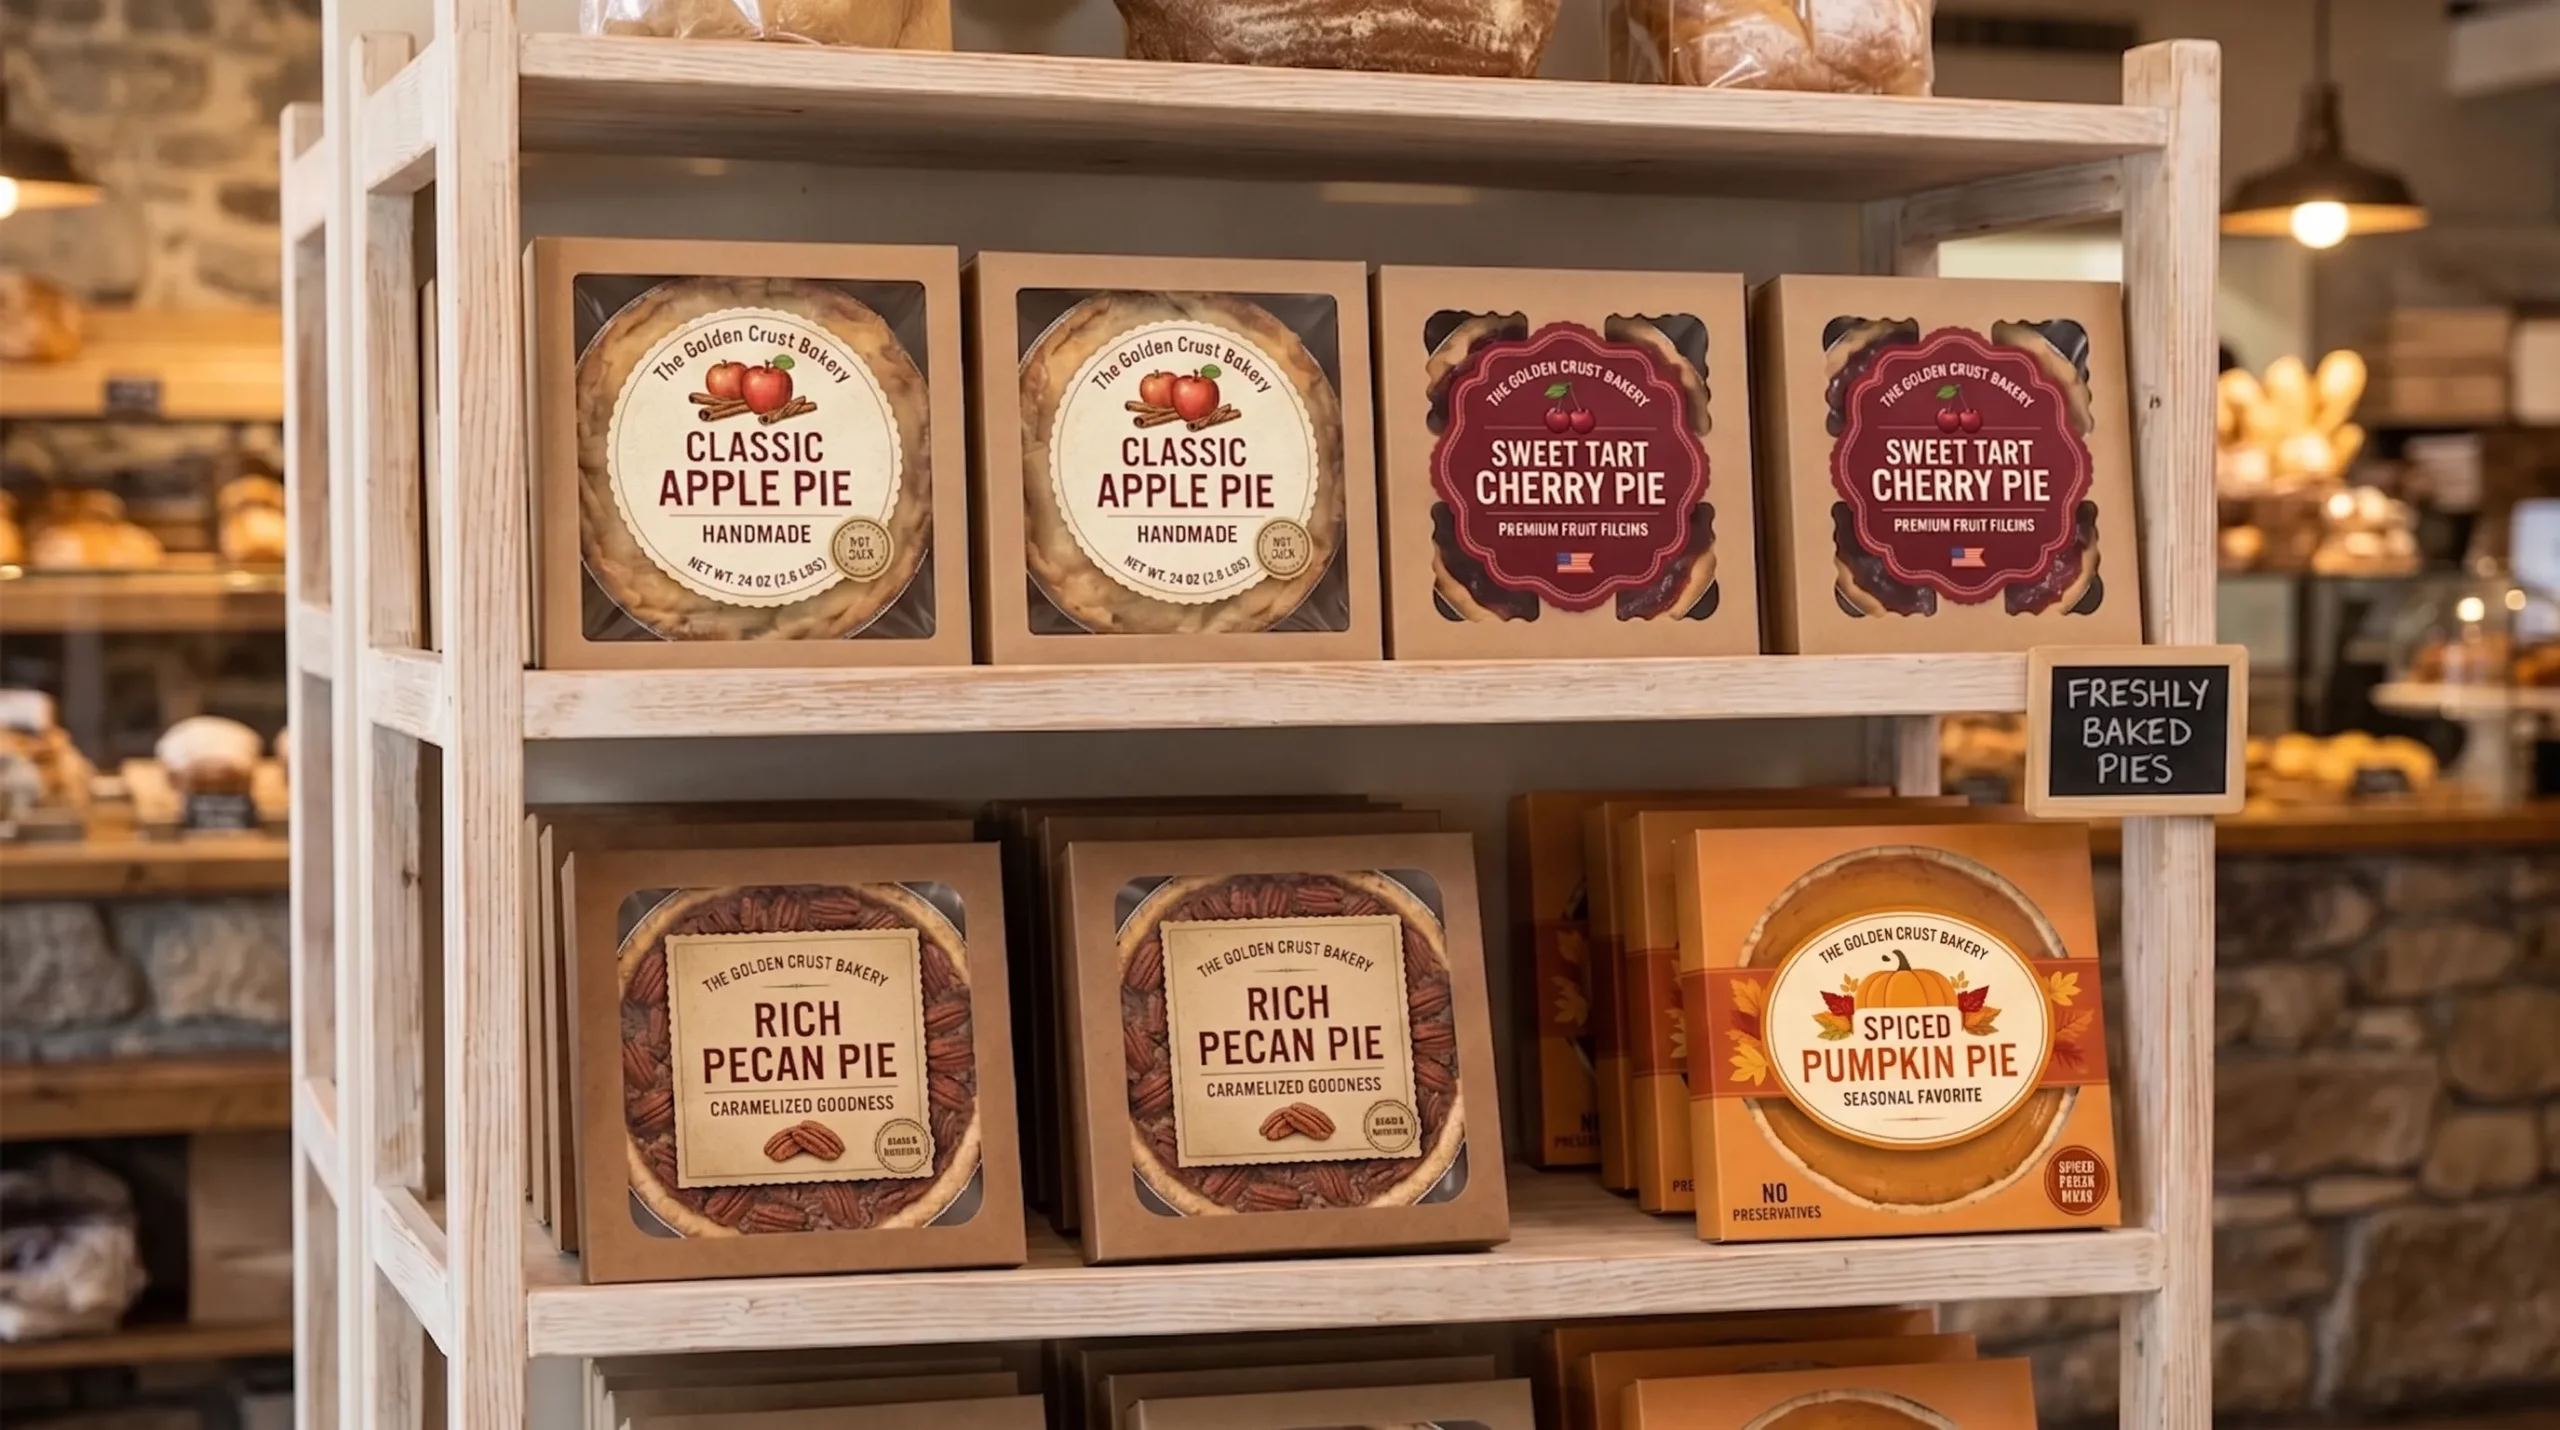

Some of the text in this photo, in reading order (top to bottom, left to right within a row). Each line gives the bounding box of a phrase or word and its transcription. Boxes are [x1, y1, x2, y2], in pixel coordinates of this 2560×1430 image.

[653, 325, 850, 385] The Golden Crust Bakery
[1091, 336, 1272, 394] The Golden Crust Bakery
[1486, 360, 1650, 408] THE GOLDEN CRUST BAKERY
[1880, 362, 2035, 408] THE GOLDEN CRUST BAKERY
[686, 431, 823, 463] CLASSIC
[1122, 437, 1246, 466] CLASSIC
[1491, 440, 1648, 468] SWEET TART
[1886, 440, 2033, 465] SWEET TART
[659, 470, 852, 507] APPLE PIE
[1097, 474, 1274, 508] APPLE PIE
[1476, 471, 1666, 505] CHERRY PIE
[1872, 470, 2050, 501] CHERRY PIE
[702, 524, 811, 544] HANDMADE
[1137, 525, 1238, 544] HANDMADE
[1498, 522, 1558, 536] PREMIUM
[1562, 522, 1598, 536] FRUIT
[1894, 518, 1950, 532] PREMIUM
[1954, 518, 1988, 532] FRUIT
[688, 556, 712, 575] NET
[714, 568, 734, 584] WT.
[738, 574, 752, 586] 24
[800, 557, 826, 579] LBS)
[1124, 556, 1146, 573] NET
[1148, 567, 1166, 582] WT.
[1170, 572, 1182, 584] 24
[2068, 678, 2209, 710] FRESHLY
[2082, 716, 2192, 748] BAKED
[2098, 752, 2173, 784] PIES
[1196, 940, 1374, 978] THE GOLDEN CRUST BAKERY
[1819, 926, 1989, 964] THE GOLDEN CRUST BAKERY
[702, 954, 889, 993] THE GOLDEN CRUST BAKERY
[1248, 985, 1330, 1021] RICH
[754, 1001, 841, 1038] RICH
[1864, 1014, 1951, 1040] SPICED
[1199, 1026, 1384, 1066] PECAN PIE
[703, 1042, 898, 1084] PECAN PIE
[1802, 1044, 2018, 1084] PUMPKIN PIE
[1206, 1077, 1382, 1098] CARAMELIZED GOODNESS
[1843, 1087, 1982, 1107] SEASONAL FAVORITE
[710, 1095, 894, 1117] CARAMELIZED GOODNESS
[1762, 1183, 1788, 1203] NO
[1732, 1205, 1822, 1221] PRESERVATIVES
